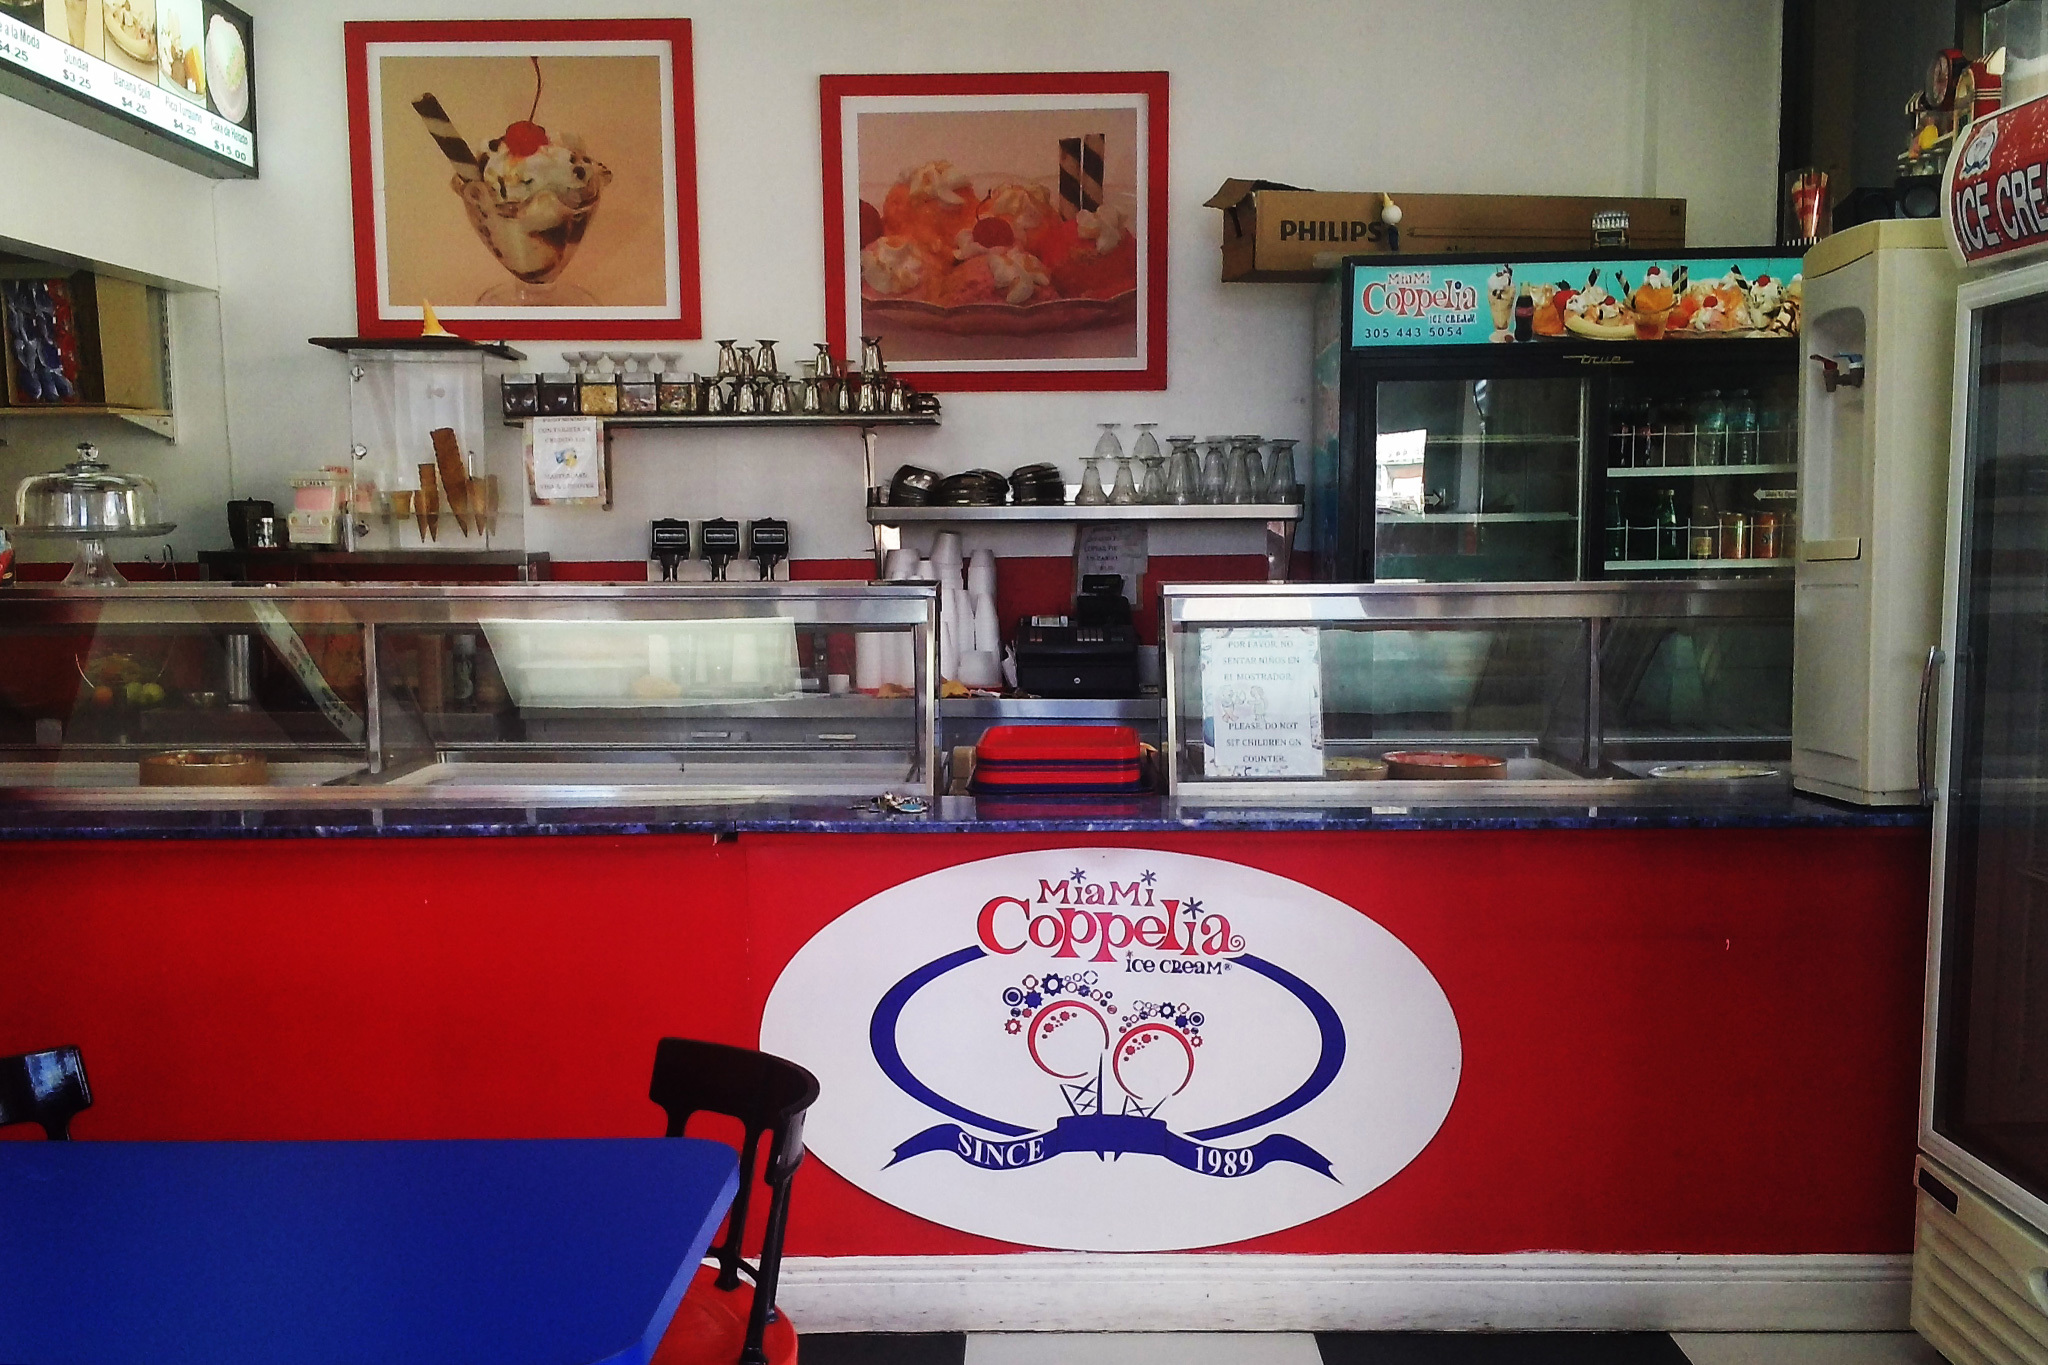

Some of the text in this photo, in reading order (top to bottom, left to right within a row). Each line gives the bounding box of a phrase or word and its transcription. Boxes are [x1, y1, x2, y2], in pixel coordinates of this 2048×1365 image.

[20, 28, 40, 50] Moda
[213, 139, 247, 162] $15.00
[1956, 163, 2048, 252] ICE CRE
[1280, 219, 1383, 242] PHILIPS
[1362, 279, 1477, 318] Coppelia
[1364, 326, 1463, 339] 305 443 5054
[1228, 640, 1247, 648] POR
[1280, 640, 1293, 648] NO
[1223, 656, 1257, 665] SENTAR
[1287, 656, 1300, 664] EN
[1265, 721, 1278, 730] DO
[1279, 721, 1299, 730] NOT
[1226, 738, 1302, 747] SIT CHILDREN ON
[976, 895, 1246, 963] Coppelia
[957, 1130, 1254, 1177] SINCE 1989
